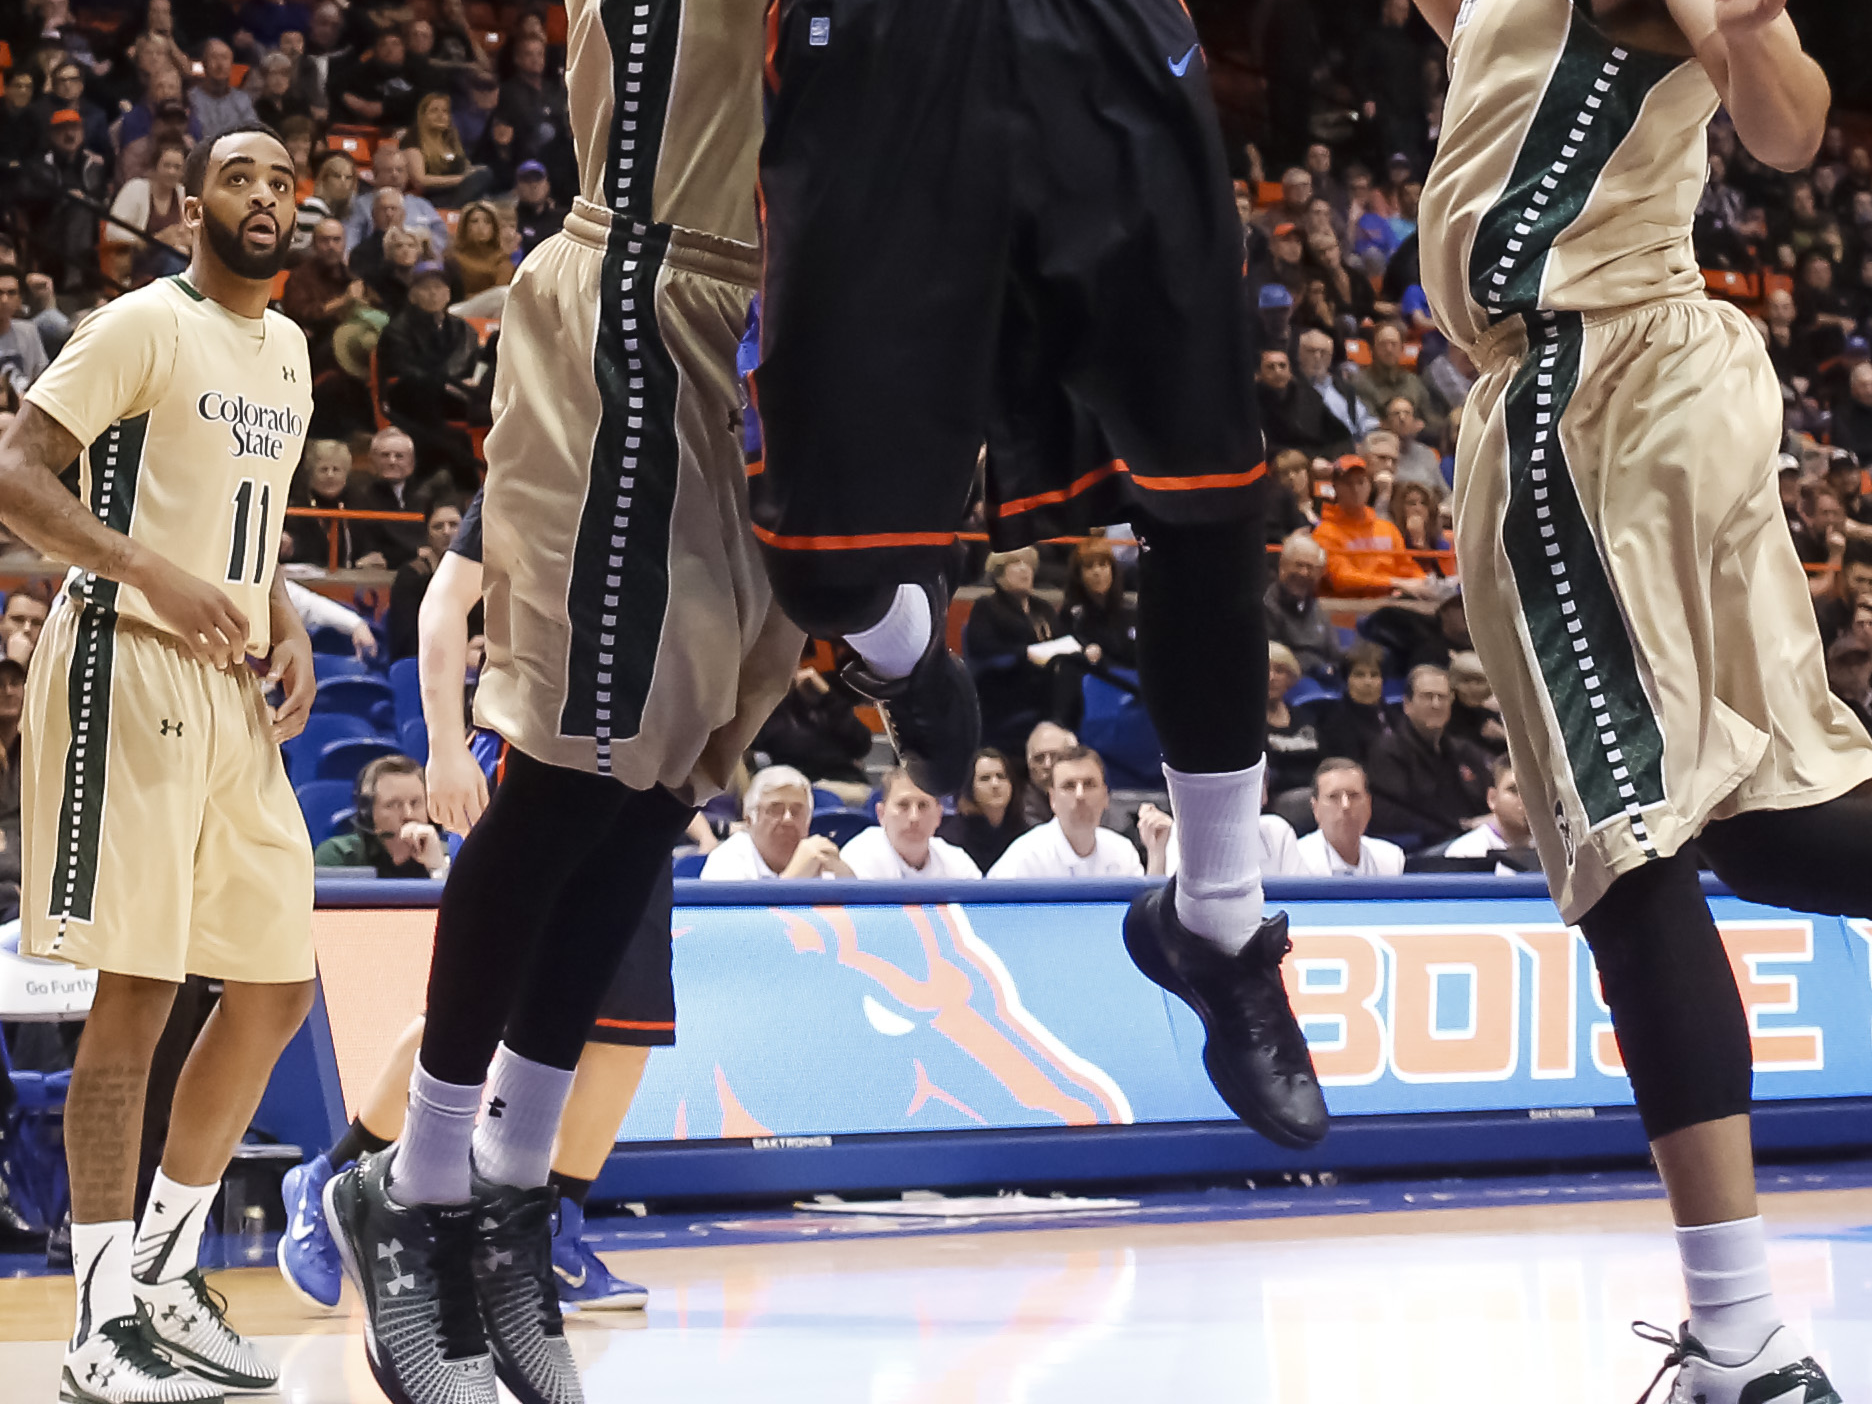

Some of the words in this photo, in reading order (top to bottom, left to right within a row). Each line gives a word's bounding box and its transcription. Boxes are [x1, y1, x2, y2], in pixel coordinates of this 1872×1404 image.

[198, 392, 303, 437] Colorado
[229, 423, 284, 461] State
[225, 478, 271, 585] 11
[1279, 920, 1824, 1086] BOIE
